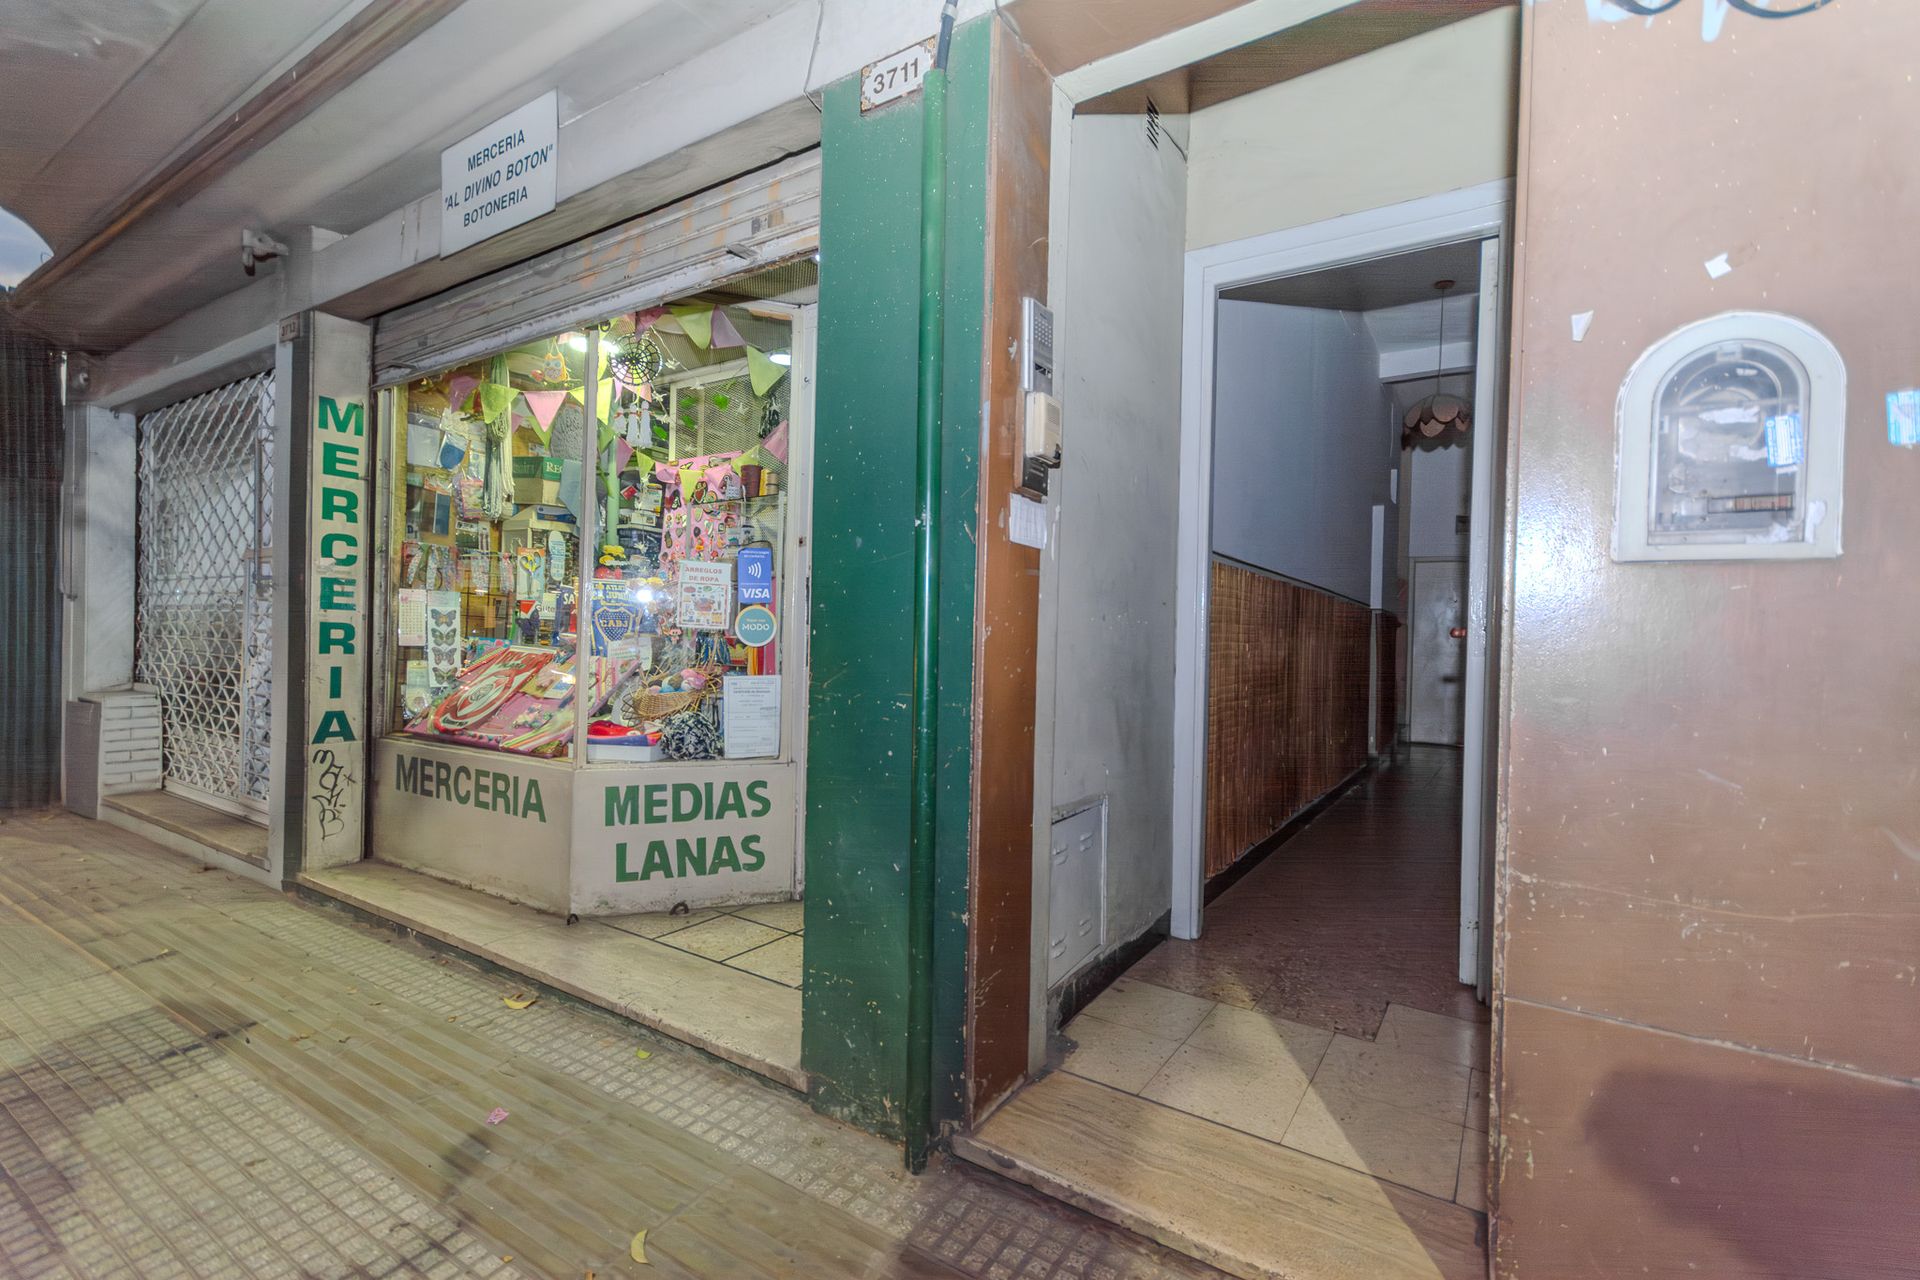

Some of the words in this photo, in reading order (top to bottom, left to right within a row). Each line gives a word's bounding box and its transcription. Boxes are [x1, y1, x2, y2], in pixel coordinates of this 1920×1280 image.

[873, 57, 919, 95] 3711
[467, 129, 526, 172] MERCERIA
[464, 170, 501, 202] DIVINO
[506, 143, 554, 181] BOTON"
[463, 186, 528, 227] BOTONERIA
[311, 395, 365, 745] MERCERIA
[684, 566, 723, 575] ARREGLOS
[741, 588, 770, 599] VISA
[601, 619, 628, 628] CABJ
[742, 623, 770, 632] MODO
[395, 754, 547, 823] MERCERIA
[604, 780, 772, 827] MEDIAS
[615, 834, 766, 883] LANAS
